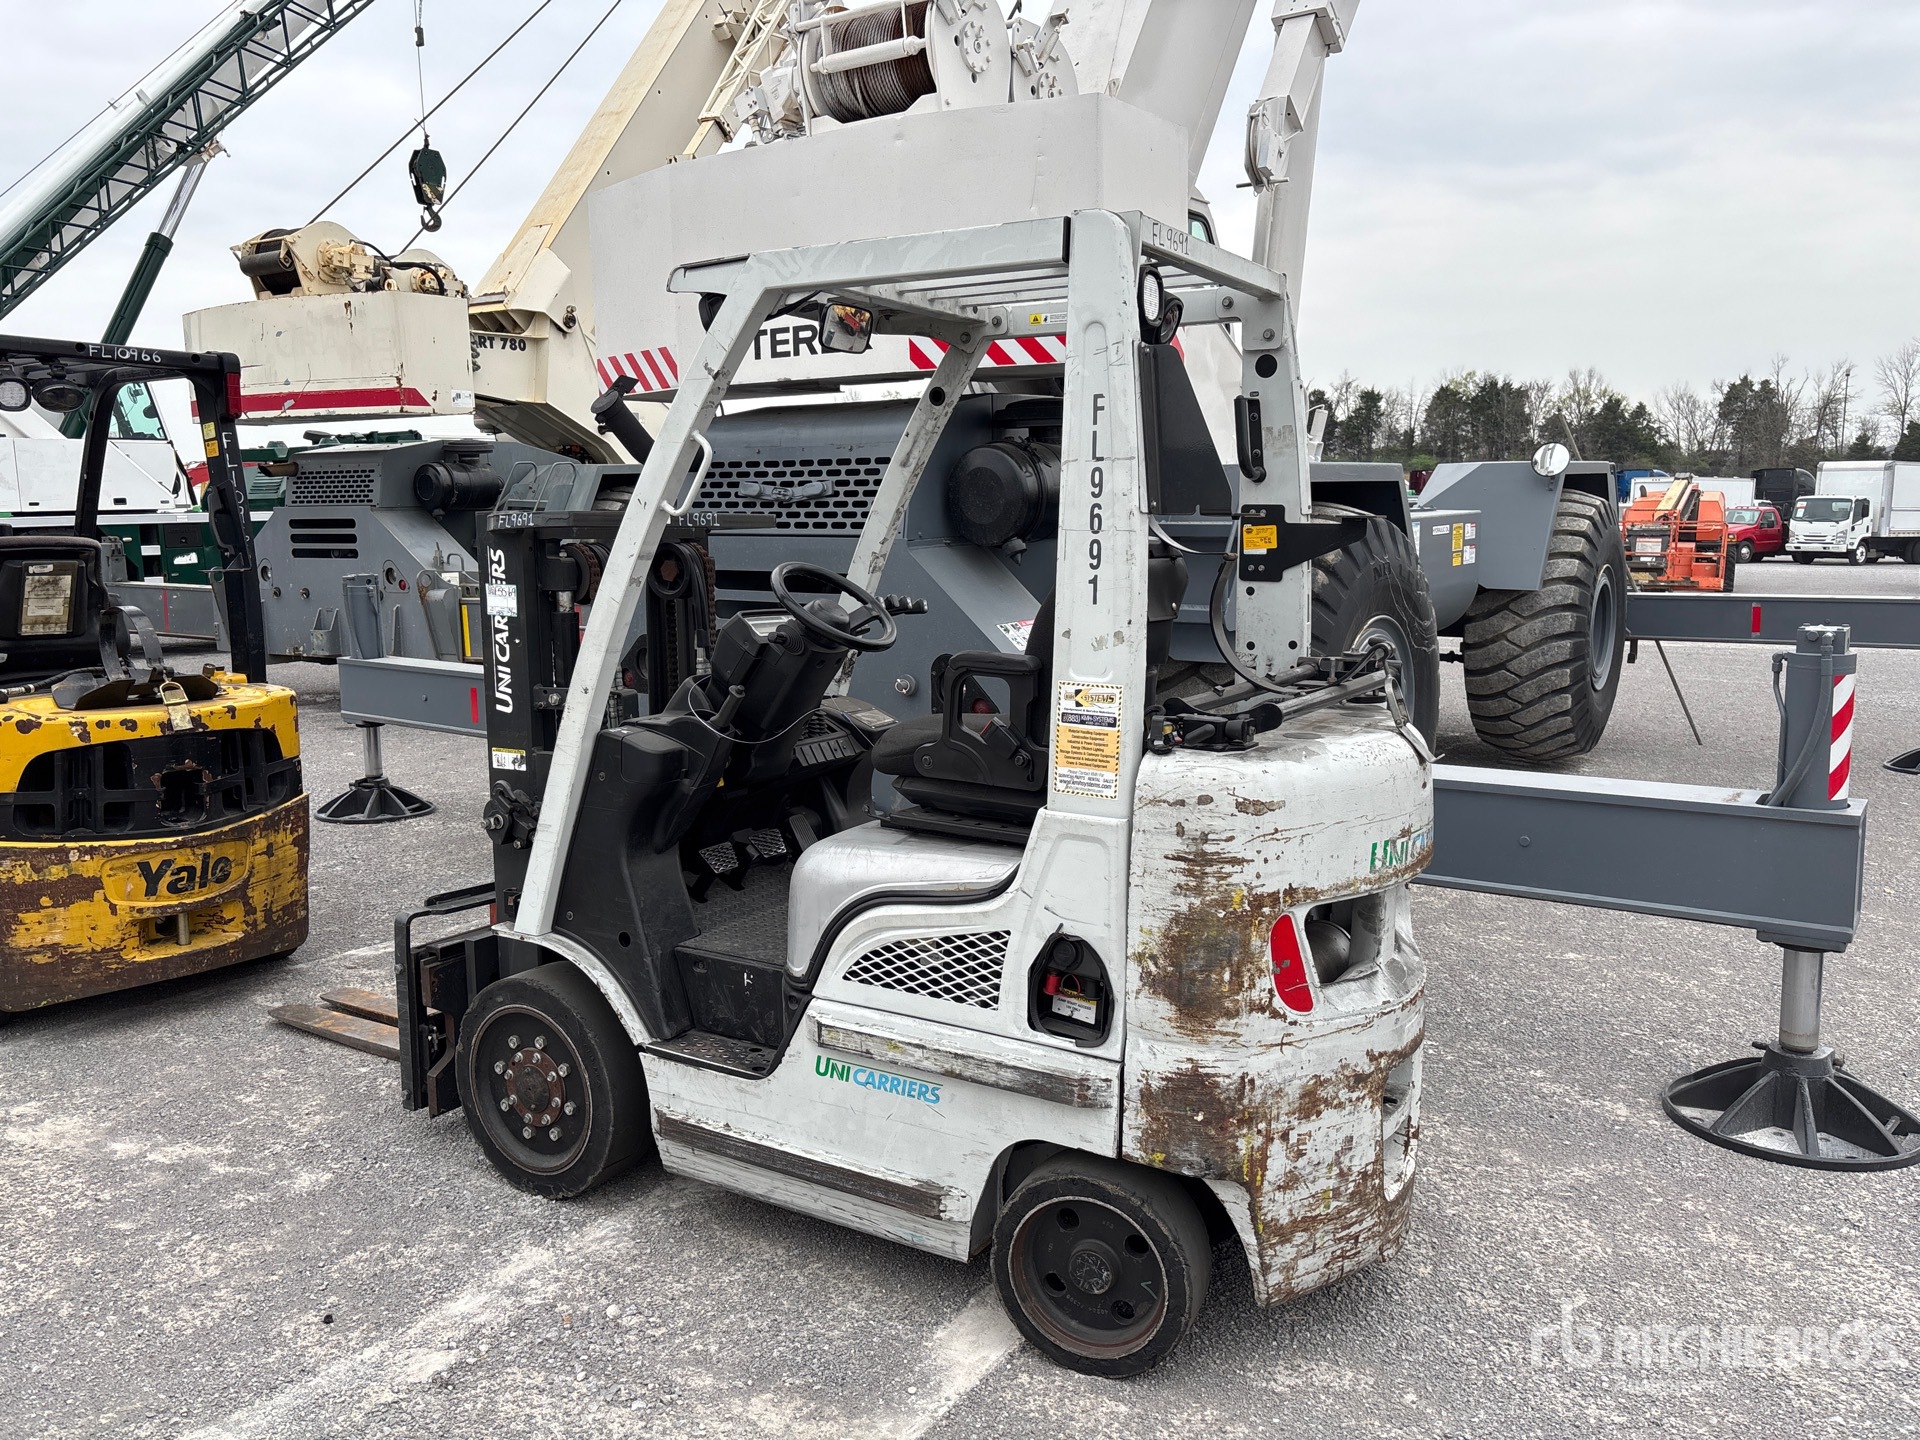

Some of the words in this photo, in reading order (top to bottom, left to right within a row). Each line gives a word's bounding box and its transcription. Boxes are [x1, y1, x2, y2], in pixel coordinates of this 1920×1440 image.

[1152, 222, 1190, 256] FL9691
[88, 344, 162, 363] FL10966
[478, 335, 495, 349] RT
[500, 337, 527, 351] 780
[752, 324, 872, 360] TER
[1088, 393, 1106, 605] FL9691
[497, 512, 535, 528] FL9691
[678, 512, 720, 527] FL9691
[137, 852, 233, 898] Yale
